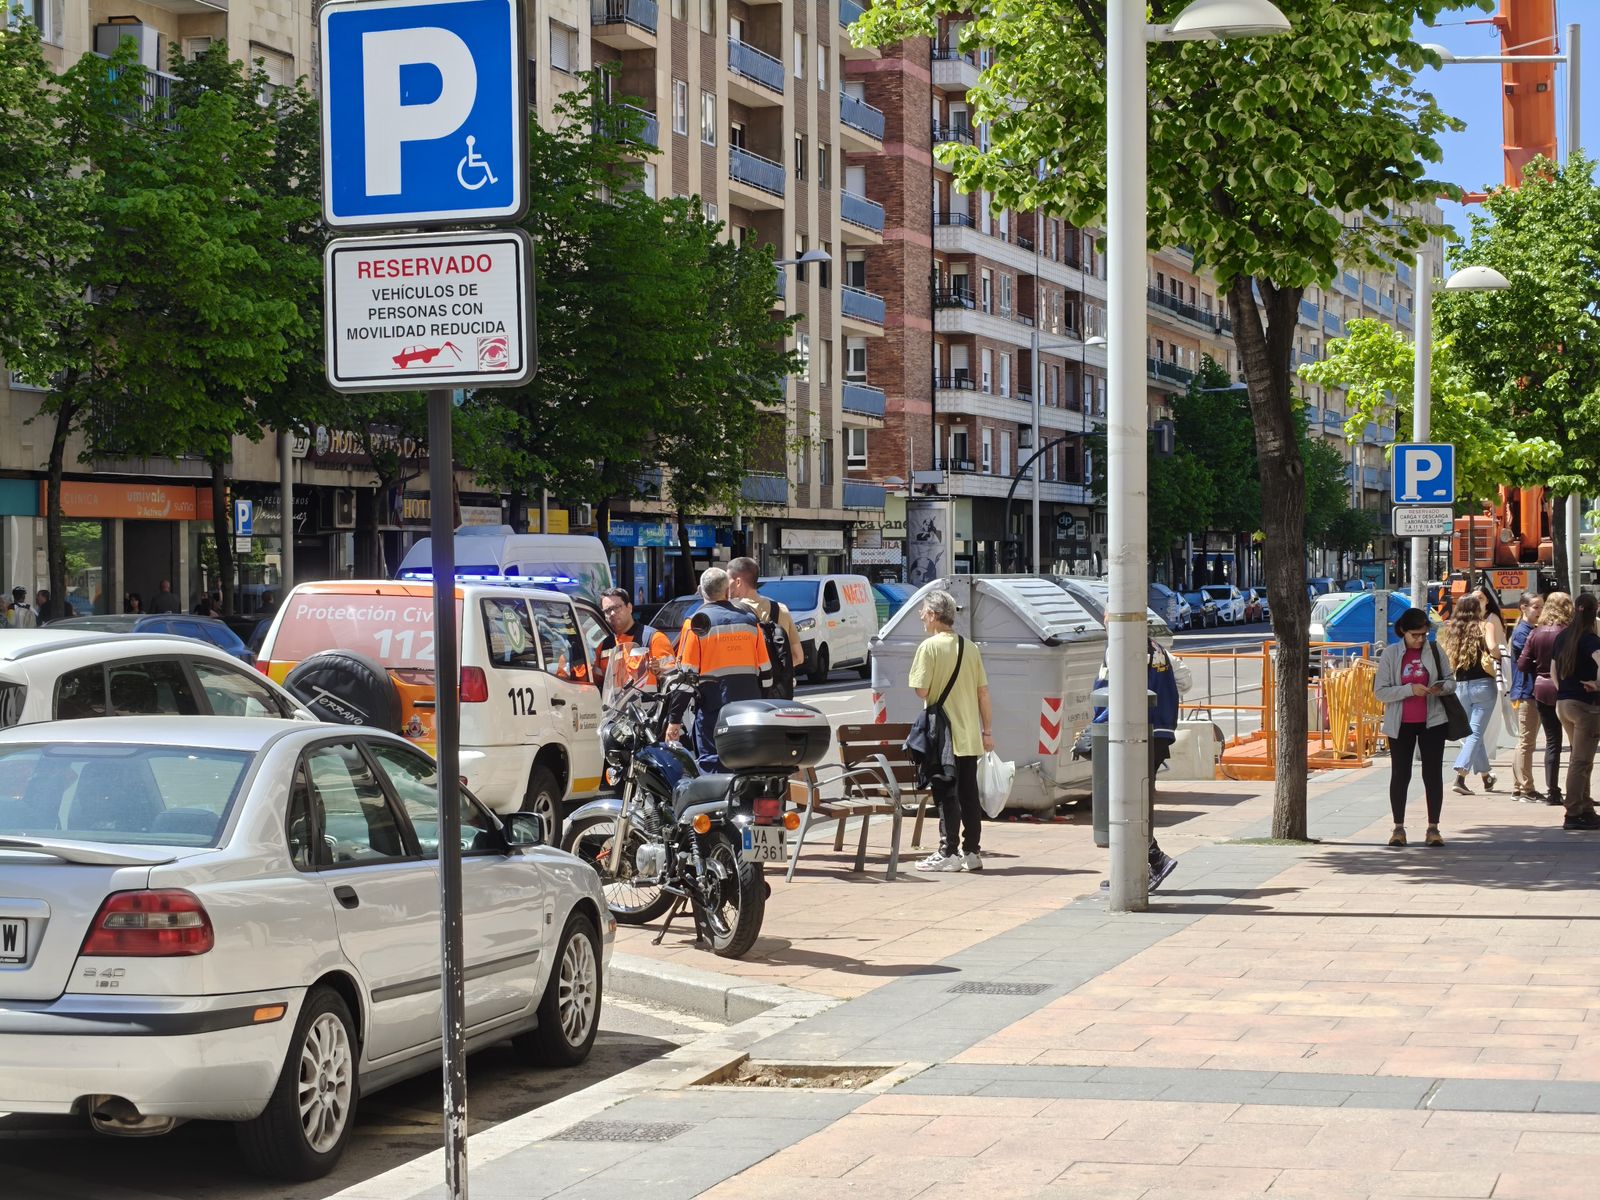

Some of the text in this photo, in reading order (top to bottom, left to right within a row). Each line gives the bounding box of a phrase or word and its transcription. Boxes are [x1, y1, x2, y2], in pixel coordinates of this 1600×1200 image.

[362, 27, 478, 197] P
[357, 253, 493, 280] RESERVADO
[372, 283, 478, 302] VEHÍCULOS DE
[368, 302, 483, 321] PERSONAS CON
[347, 320, 506, 341] MOVILIDAD REDUCIDA
[1405, 450, 1443, 497] P
[127, 487, 167, 503] umivale
[237, 503, 250, 534] P
[403, 499, 432, 519] HOT
[1058, 514, 1073, 527] dp
[841, 583, 870, 605] NACEX
[295, 603, 433, 622] Protección Civ
[372, 627, 434, 661] 112
[507, 687, 537, 716] 112
[753, 829, 785, 845] VA W
[754, 844, 784, 861] 7361
[2, 923, 18, 952] W
